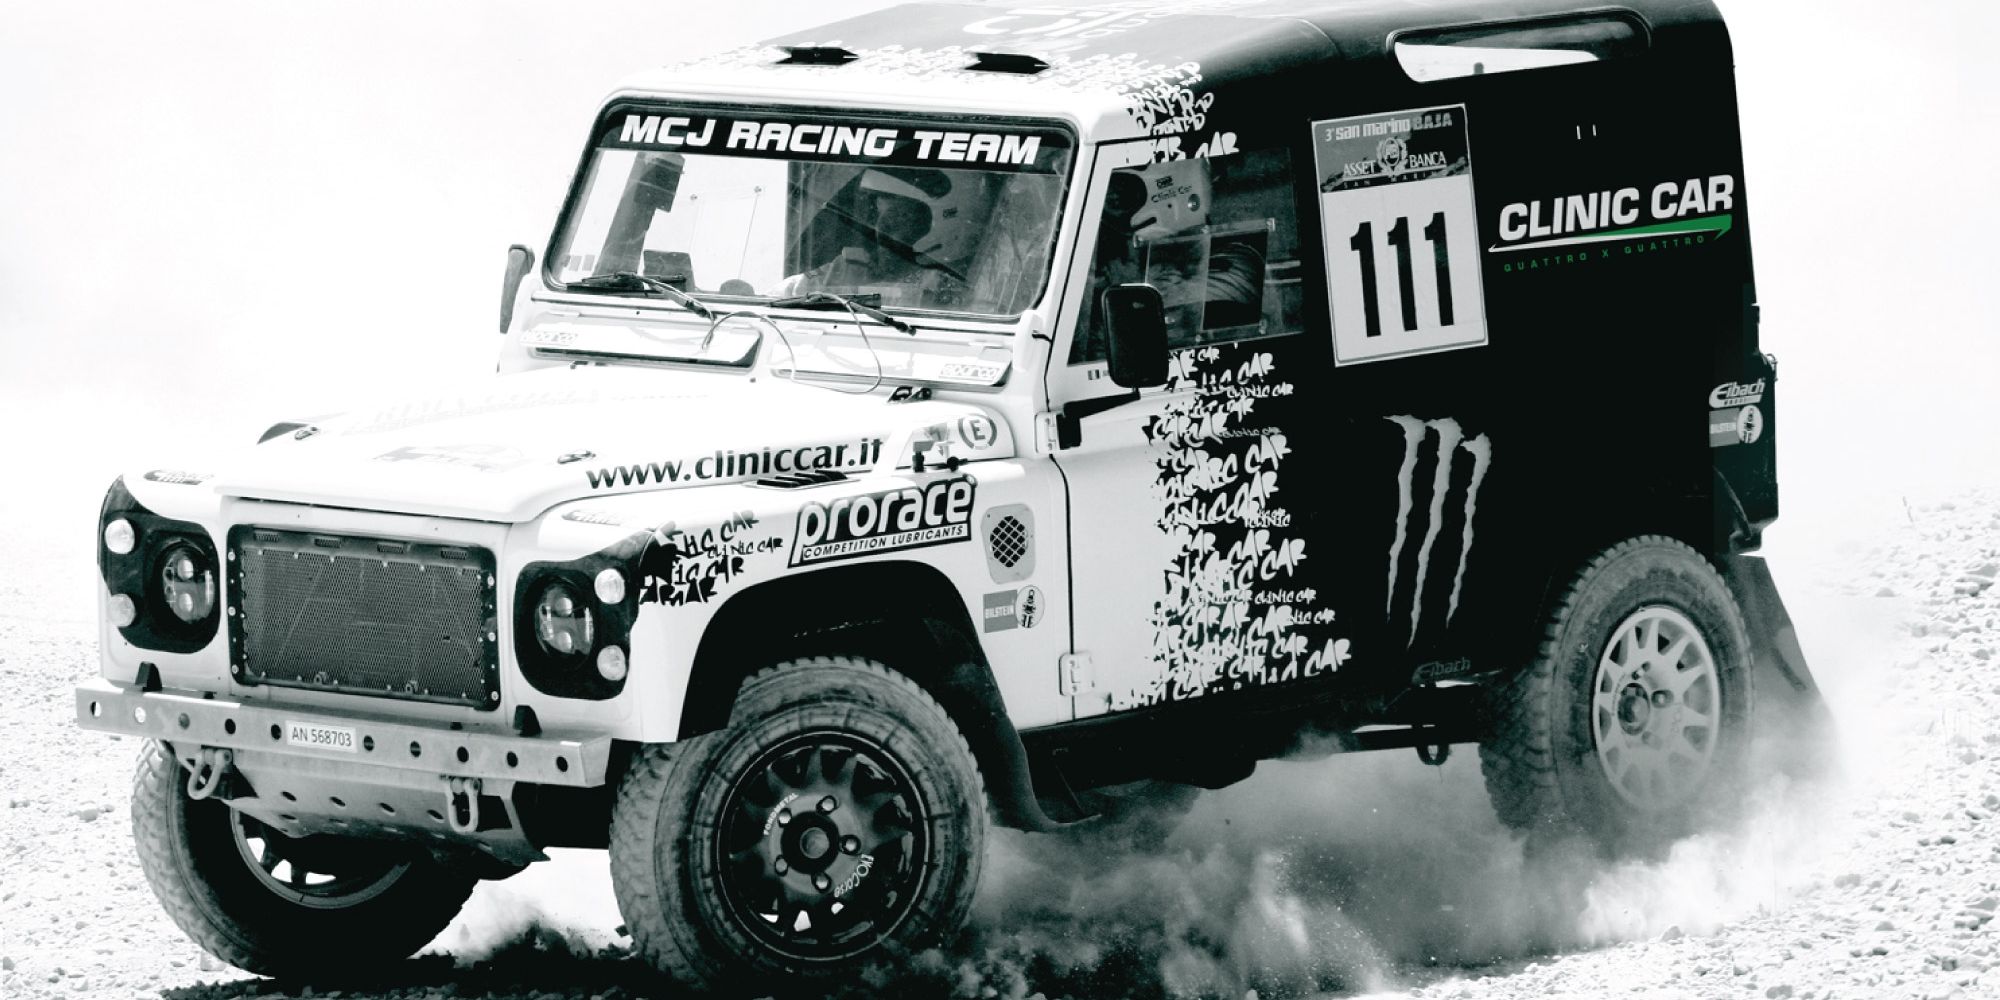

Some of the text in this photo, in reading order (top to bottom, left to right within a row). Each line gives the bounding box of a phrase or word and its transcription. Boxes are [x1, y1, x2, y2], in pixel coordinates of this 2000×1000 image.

[619, 114, 1041, 165] MCJ RACING TEAM
[1336, 125, 1361, 141] san
[1363, 118, 1411, 137] marino
[1413, 112, 1453, 131] BAJA
[1343, 151, 1447, 177] ASSET BANCA
[1499, 174, 1735, 241] CLINIC CAR
[1504, 235, 1705, 272] QUATTRO X QUATTRO
[1350, 211, 1454, 337] 111
[1709, 378, 1766, 408] Eibach
[970, 420, 986, 441] E
[586, 438, 883, 489] www.cliniccar.it
[1245, 433, 1292, 472] CAR
[792, 481, 972, 564] prorace
[756, 536, 784, 554] CAR
[804, 526, 963, 559] COMPETITION LUBRICANTS
[1261, 538, 1308, 581] CAR
[1304, 638, 1352, 678] CAR
[292, 726, 353, 747] AN 568703
